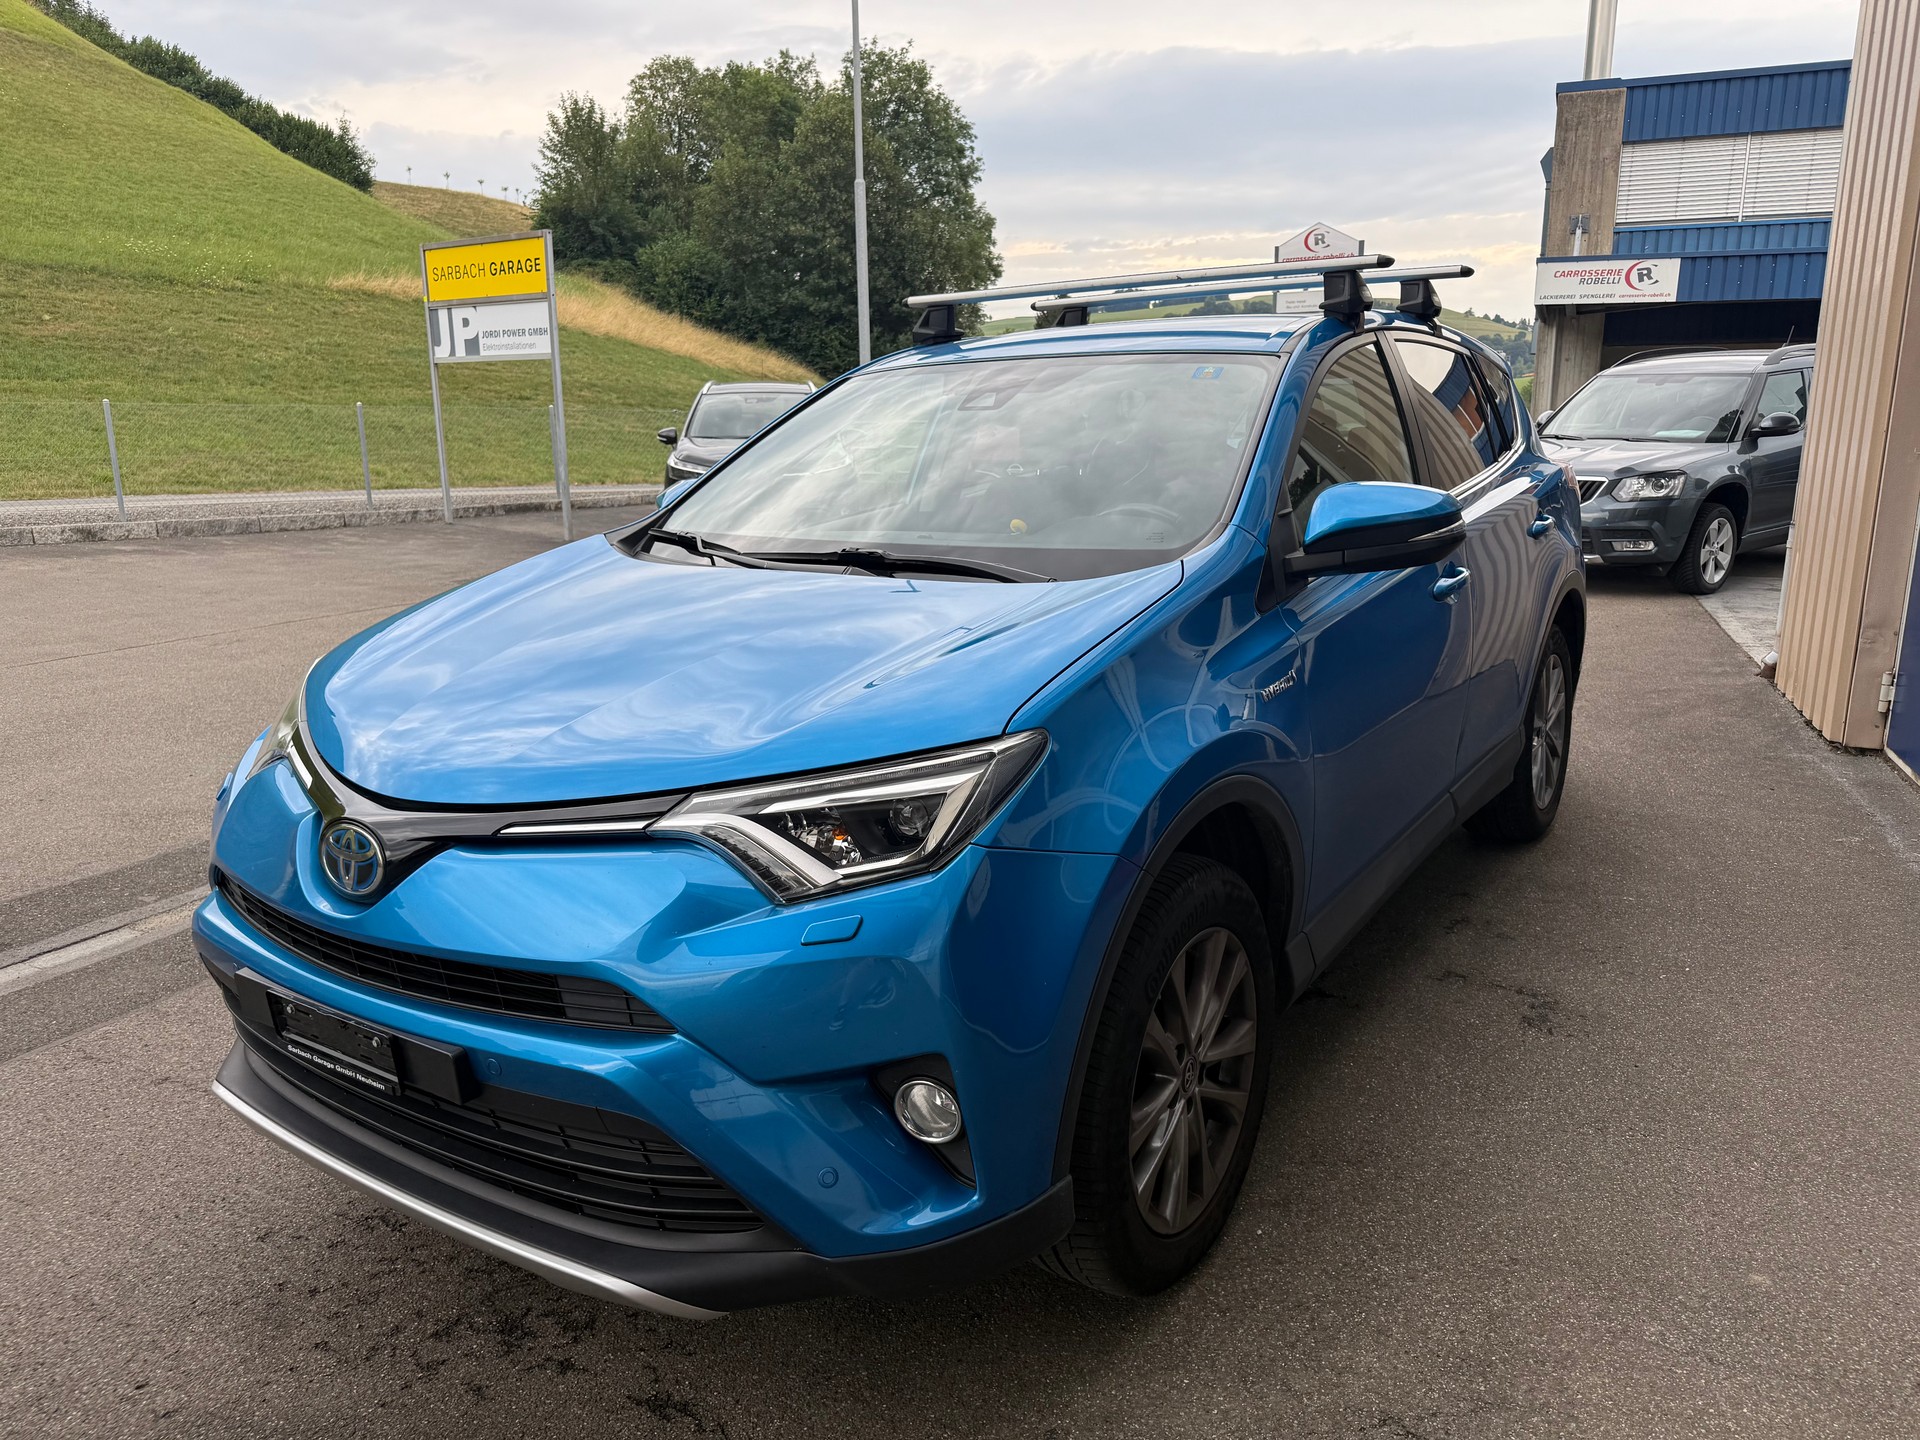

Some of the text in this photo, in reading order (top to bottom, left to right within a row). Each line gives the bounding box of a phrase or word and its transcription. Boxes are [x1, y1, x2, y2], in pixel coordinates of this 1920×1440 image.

[432, 257, 541, 282] SARBACH GARAGE
[1553, 268, 1624, 279] CARROSSERIE
[1578, 276, 1621, 286] ROBELLI
[482, 327, 549, 339] JORDI POWER GMBH
[482, 341, 537, 351] Elektroinstallationen
[287, 1044, 385, 1090] Sarbach Garage GmbH Neuheim
